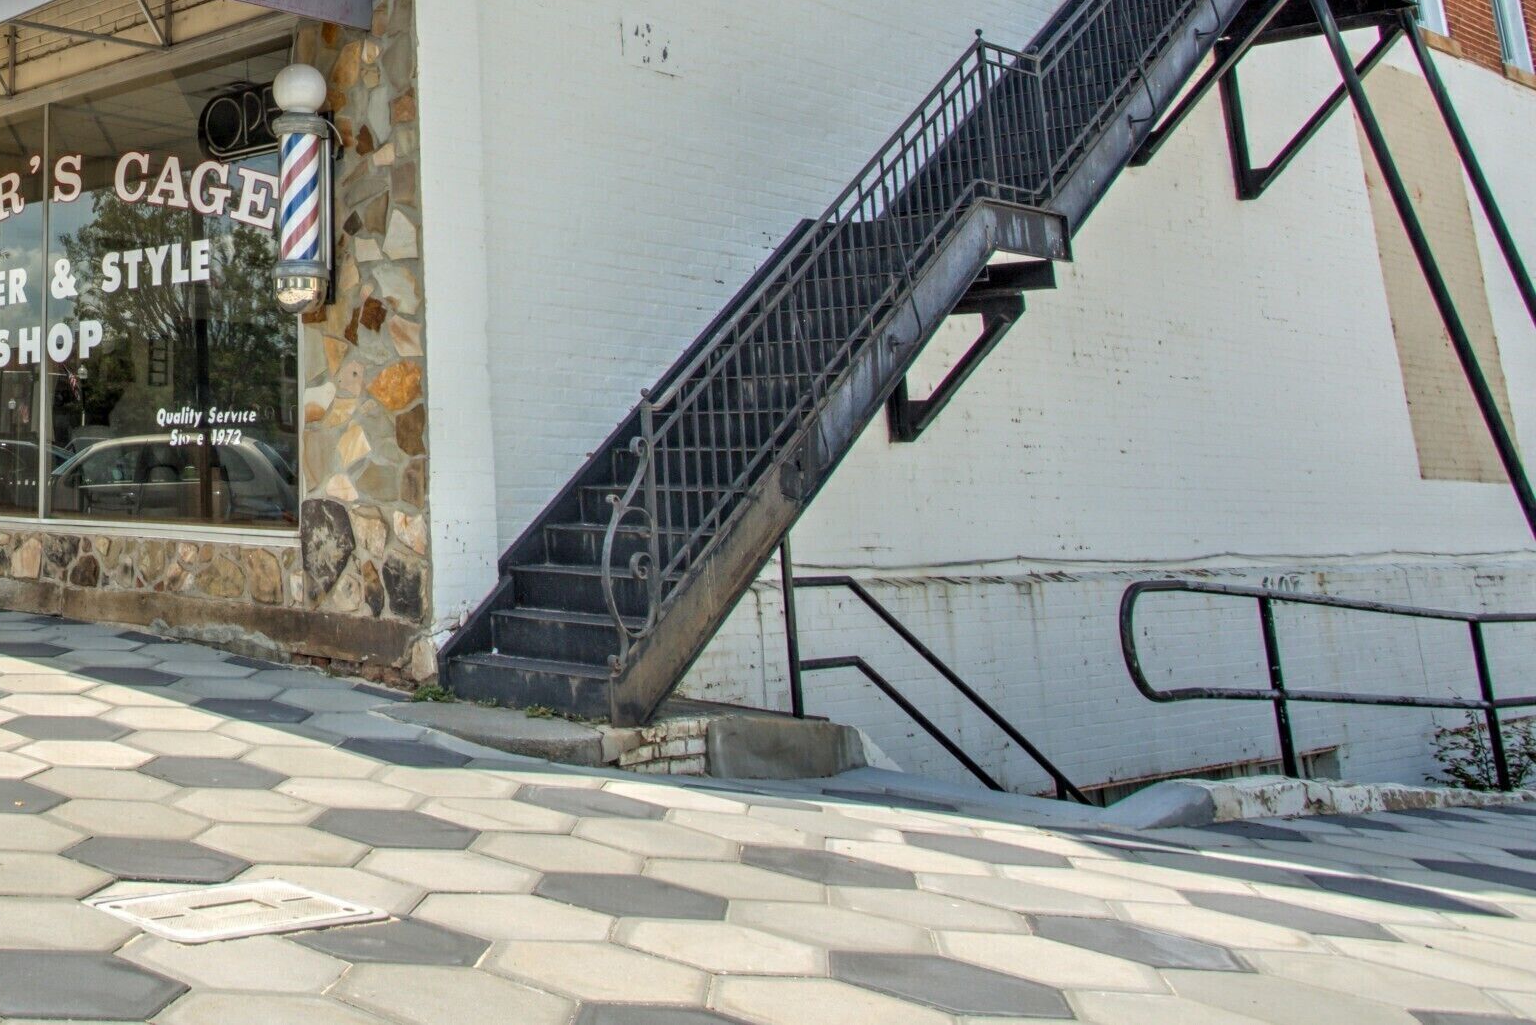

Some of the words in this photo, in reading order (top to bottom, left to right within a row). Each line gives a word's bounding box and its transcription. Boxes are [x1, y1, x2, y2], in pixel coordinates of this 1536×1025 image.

[114, 151, 280, 230] CAGE
[50, 258, 78, 299] &
[101, 238, 210, 293] STYLE
[156, 406, 203, 427] Quality
[208, 406, 257, 424] Service
[211, 428, 242, 446] 1972
